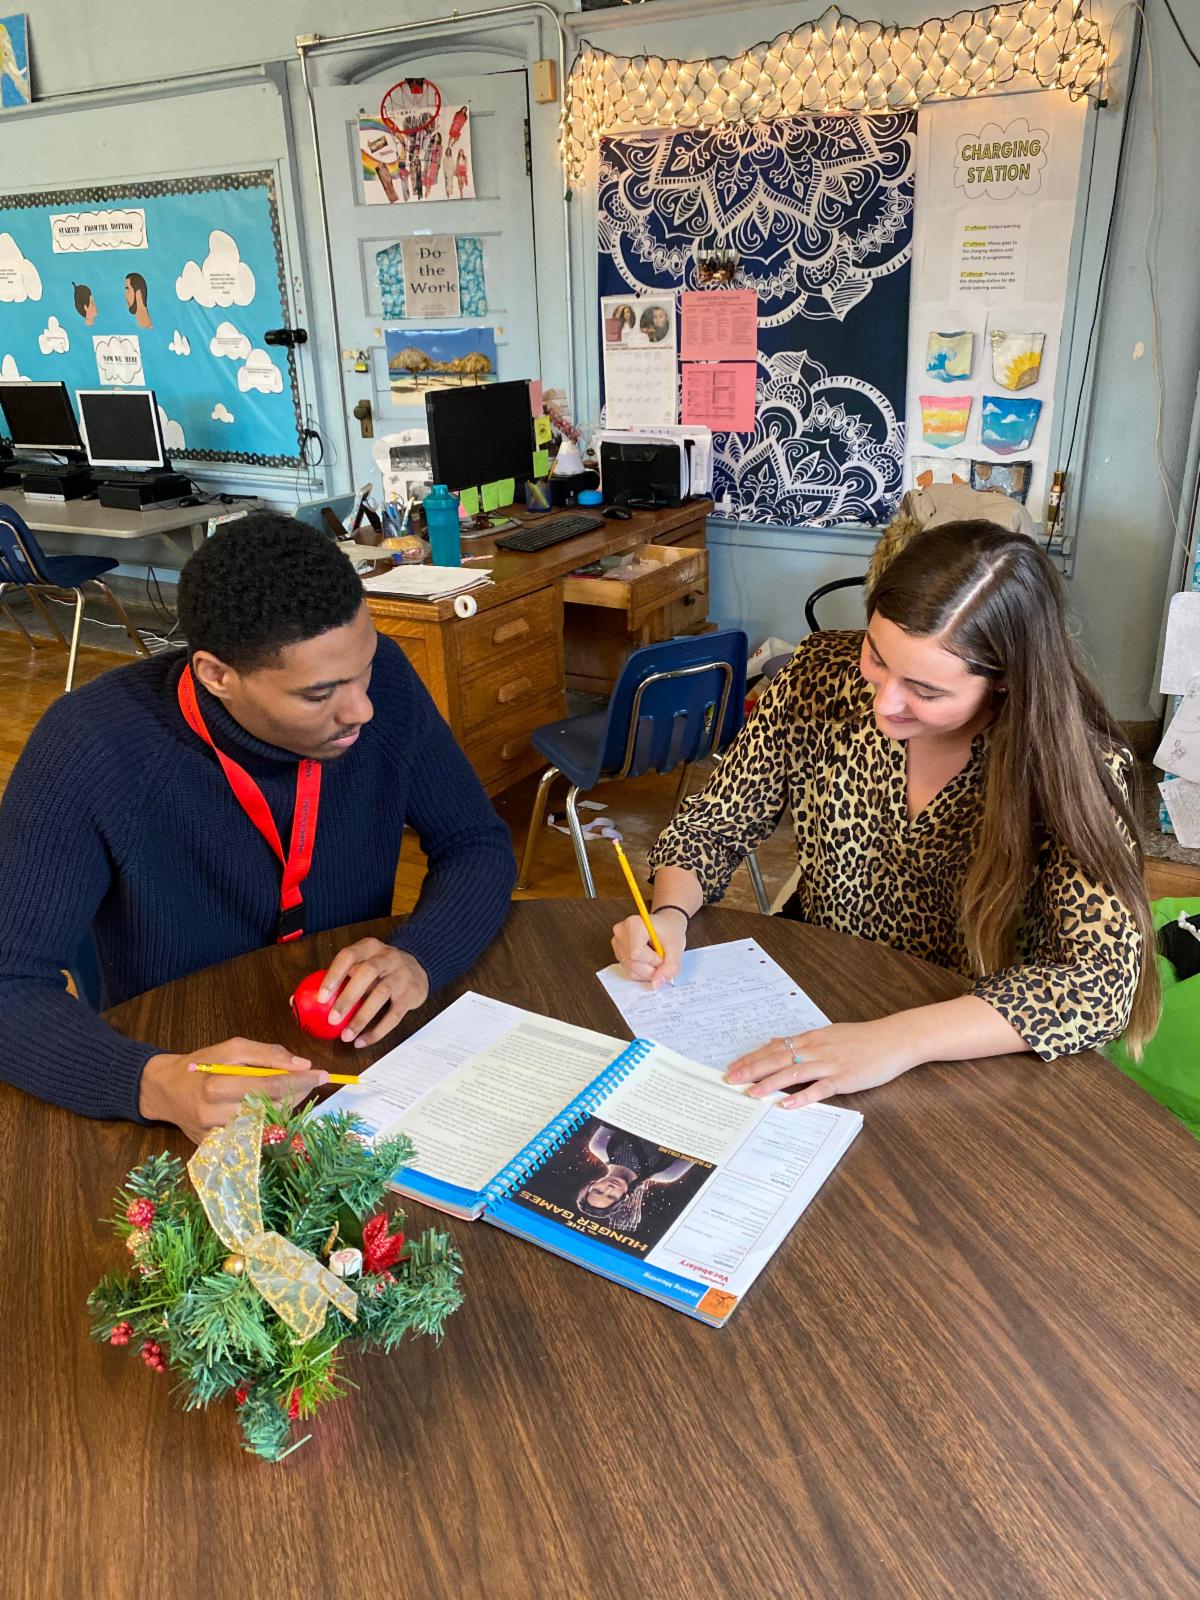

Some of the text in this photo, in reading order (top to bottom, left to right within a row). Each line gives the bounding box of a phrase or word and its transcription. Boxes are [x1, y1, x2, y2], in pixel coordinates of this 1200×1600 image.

[961, 139, 1041, 161] CHARGING
[967, 163, 1031, 183] STATION
[420, 247, 442, 259] Do
[419, 264, 445, 276] the
[410, 281, 456, 294] Work
[519, 1190, 575, 1220] GAMES
[565, 1220, 586, 1233] THE
[576, 1216, 649, 1252] HUNGER
[678, 1259, 729, 1283] Vocabulary
[642, 1271, 700, 1298] Making Meaning
